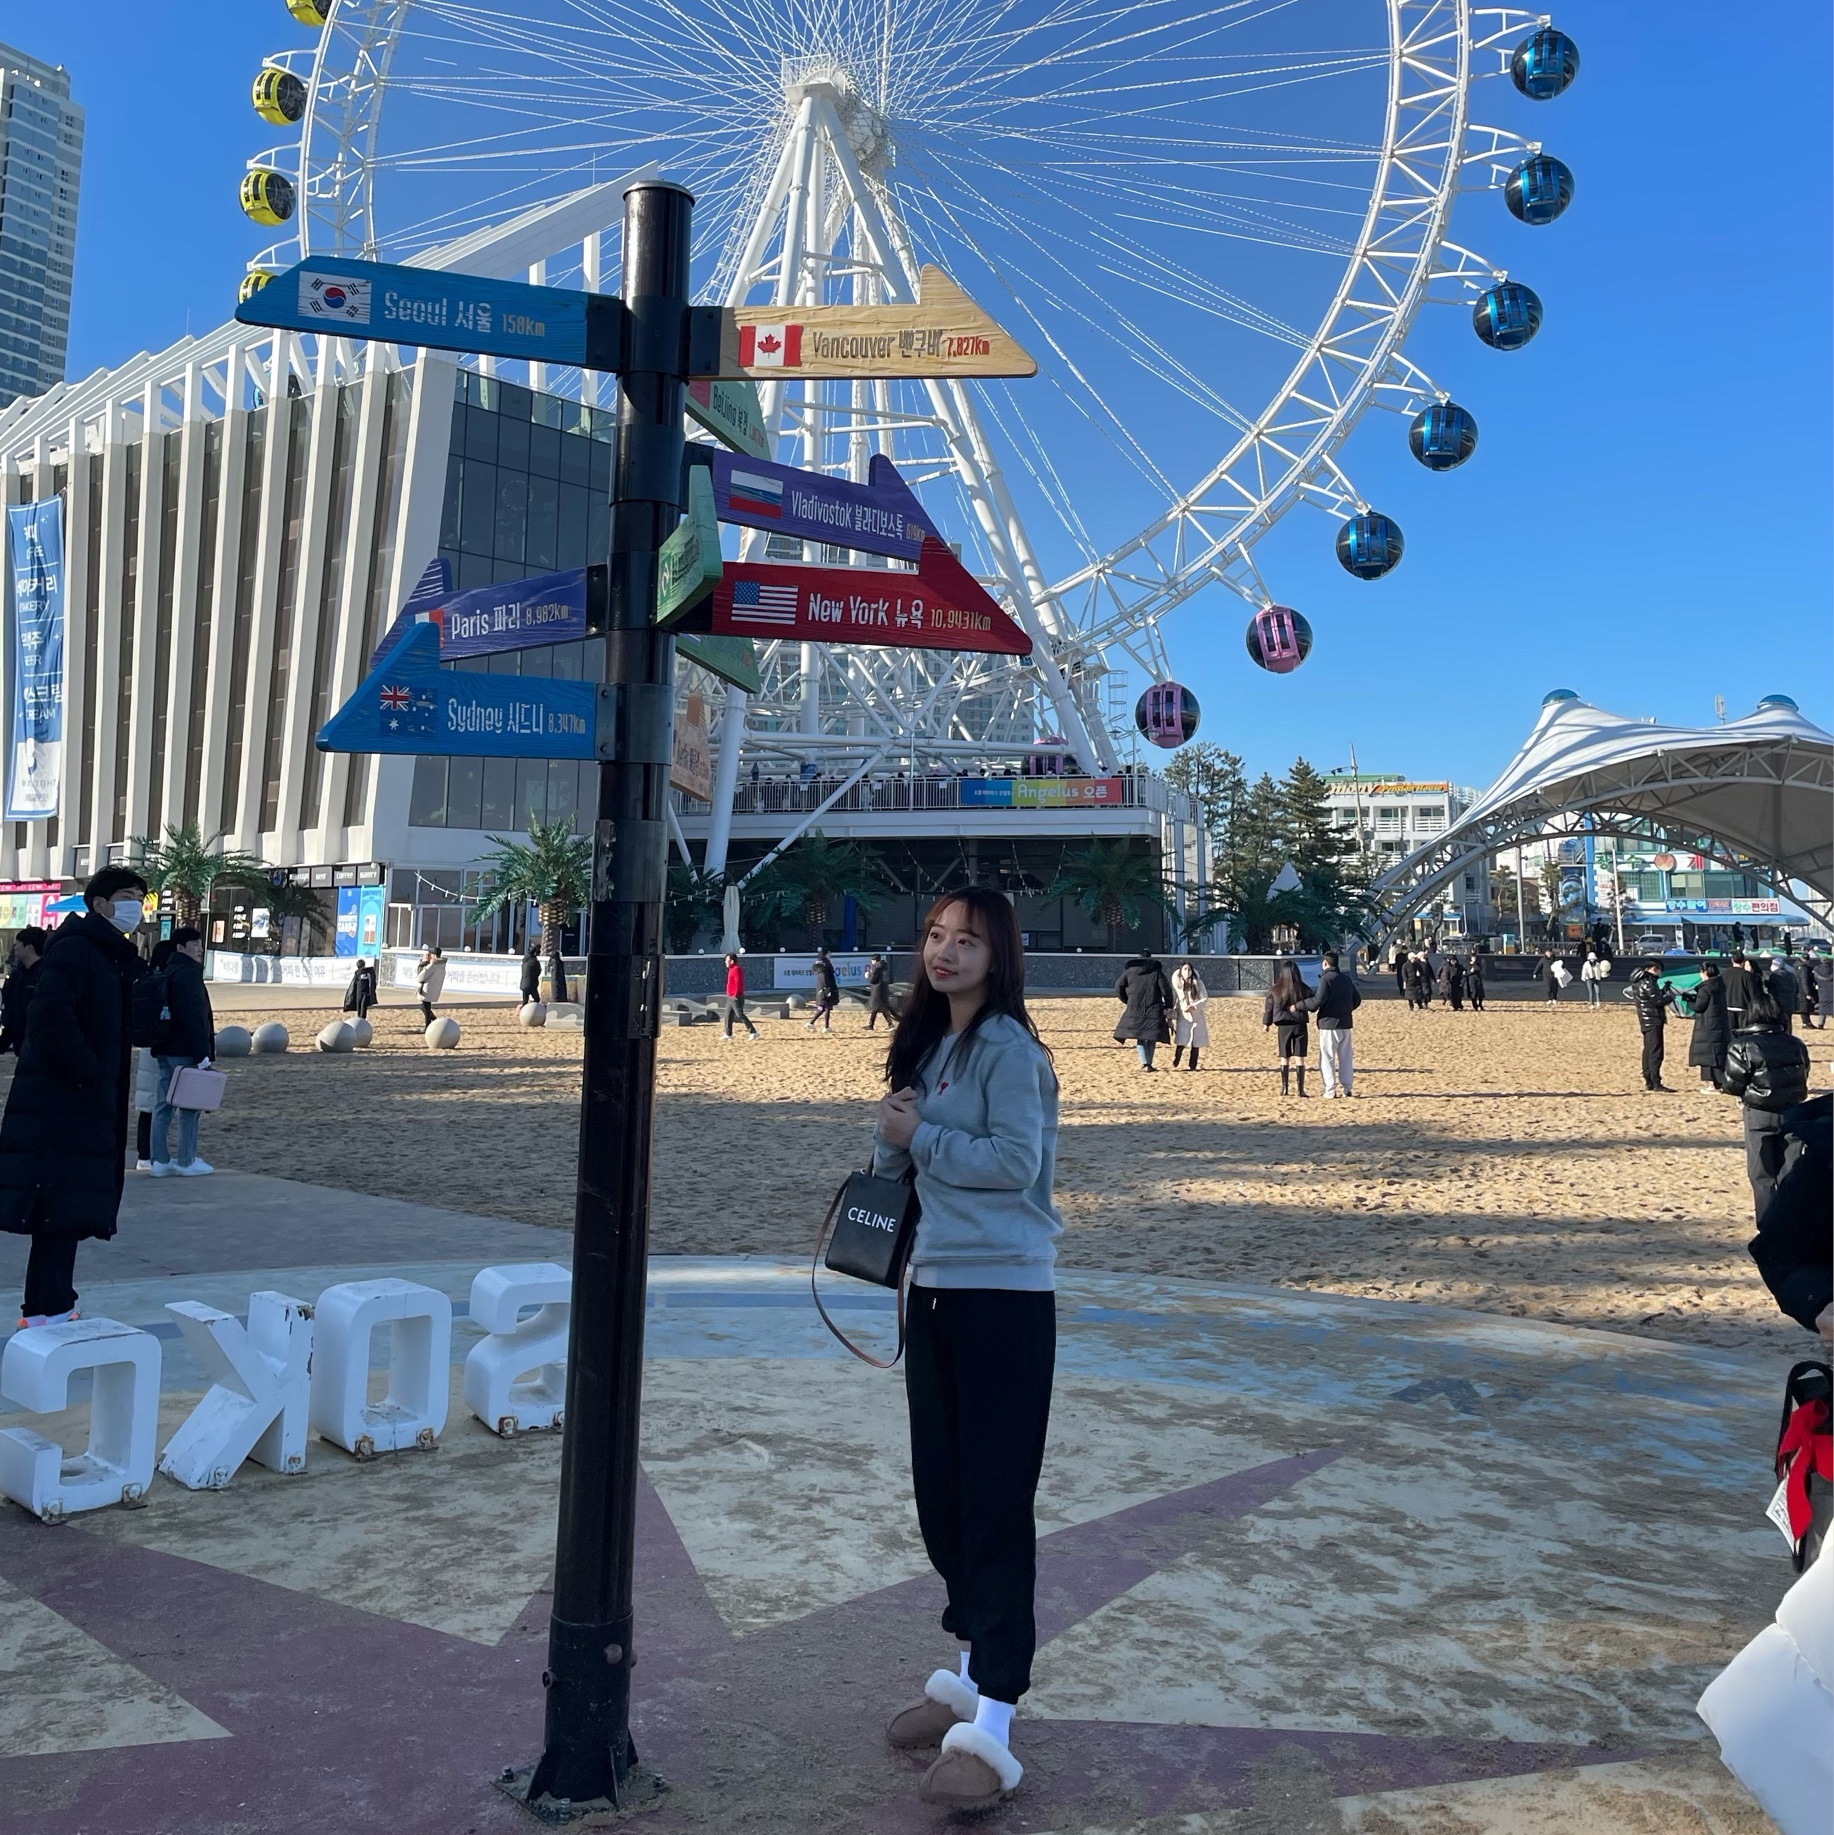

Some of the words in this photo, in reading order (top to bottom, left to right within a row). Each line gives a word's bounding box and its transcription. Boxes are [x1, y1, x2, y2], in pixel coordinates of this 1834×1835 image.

[384, 290, 447, 327] Seoul
[454, 301, 493, 333] 서울
[812, 331, 895, 358] Vancouver
[791, 490, 852, 529] Vladivostok
[451, 608, 489, 640] Paris
[493, 602, 520, 632] 파리
[808, 592, 844, 623] New
[849, 595, 890, 626] York
[895, 598, 924, 629] 뉴욕
[447, 697, 503, 734] Sydney
[506, 702, 543, 735] 시드니
[1017, 784, 1079, 804] Angelus
[1083, 785, 1108, 799] 오픈
[847, 1206, 897, 1233] CELINE
